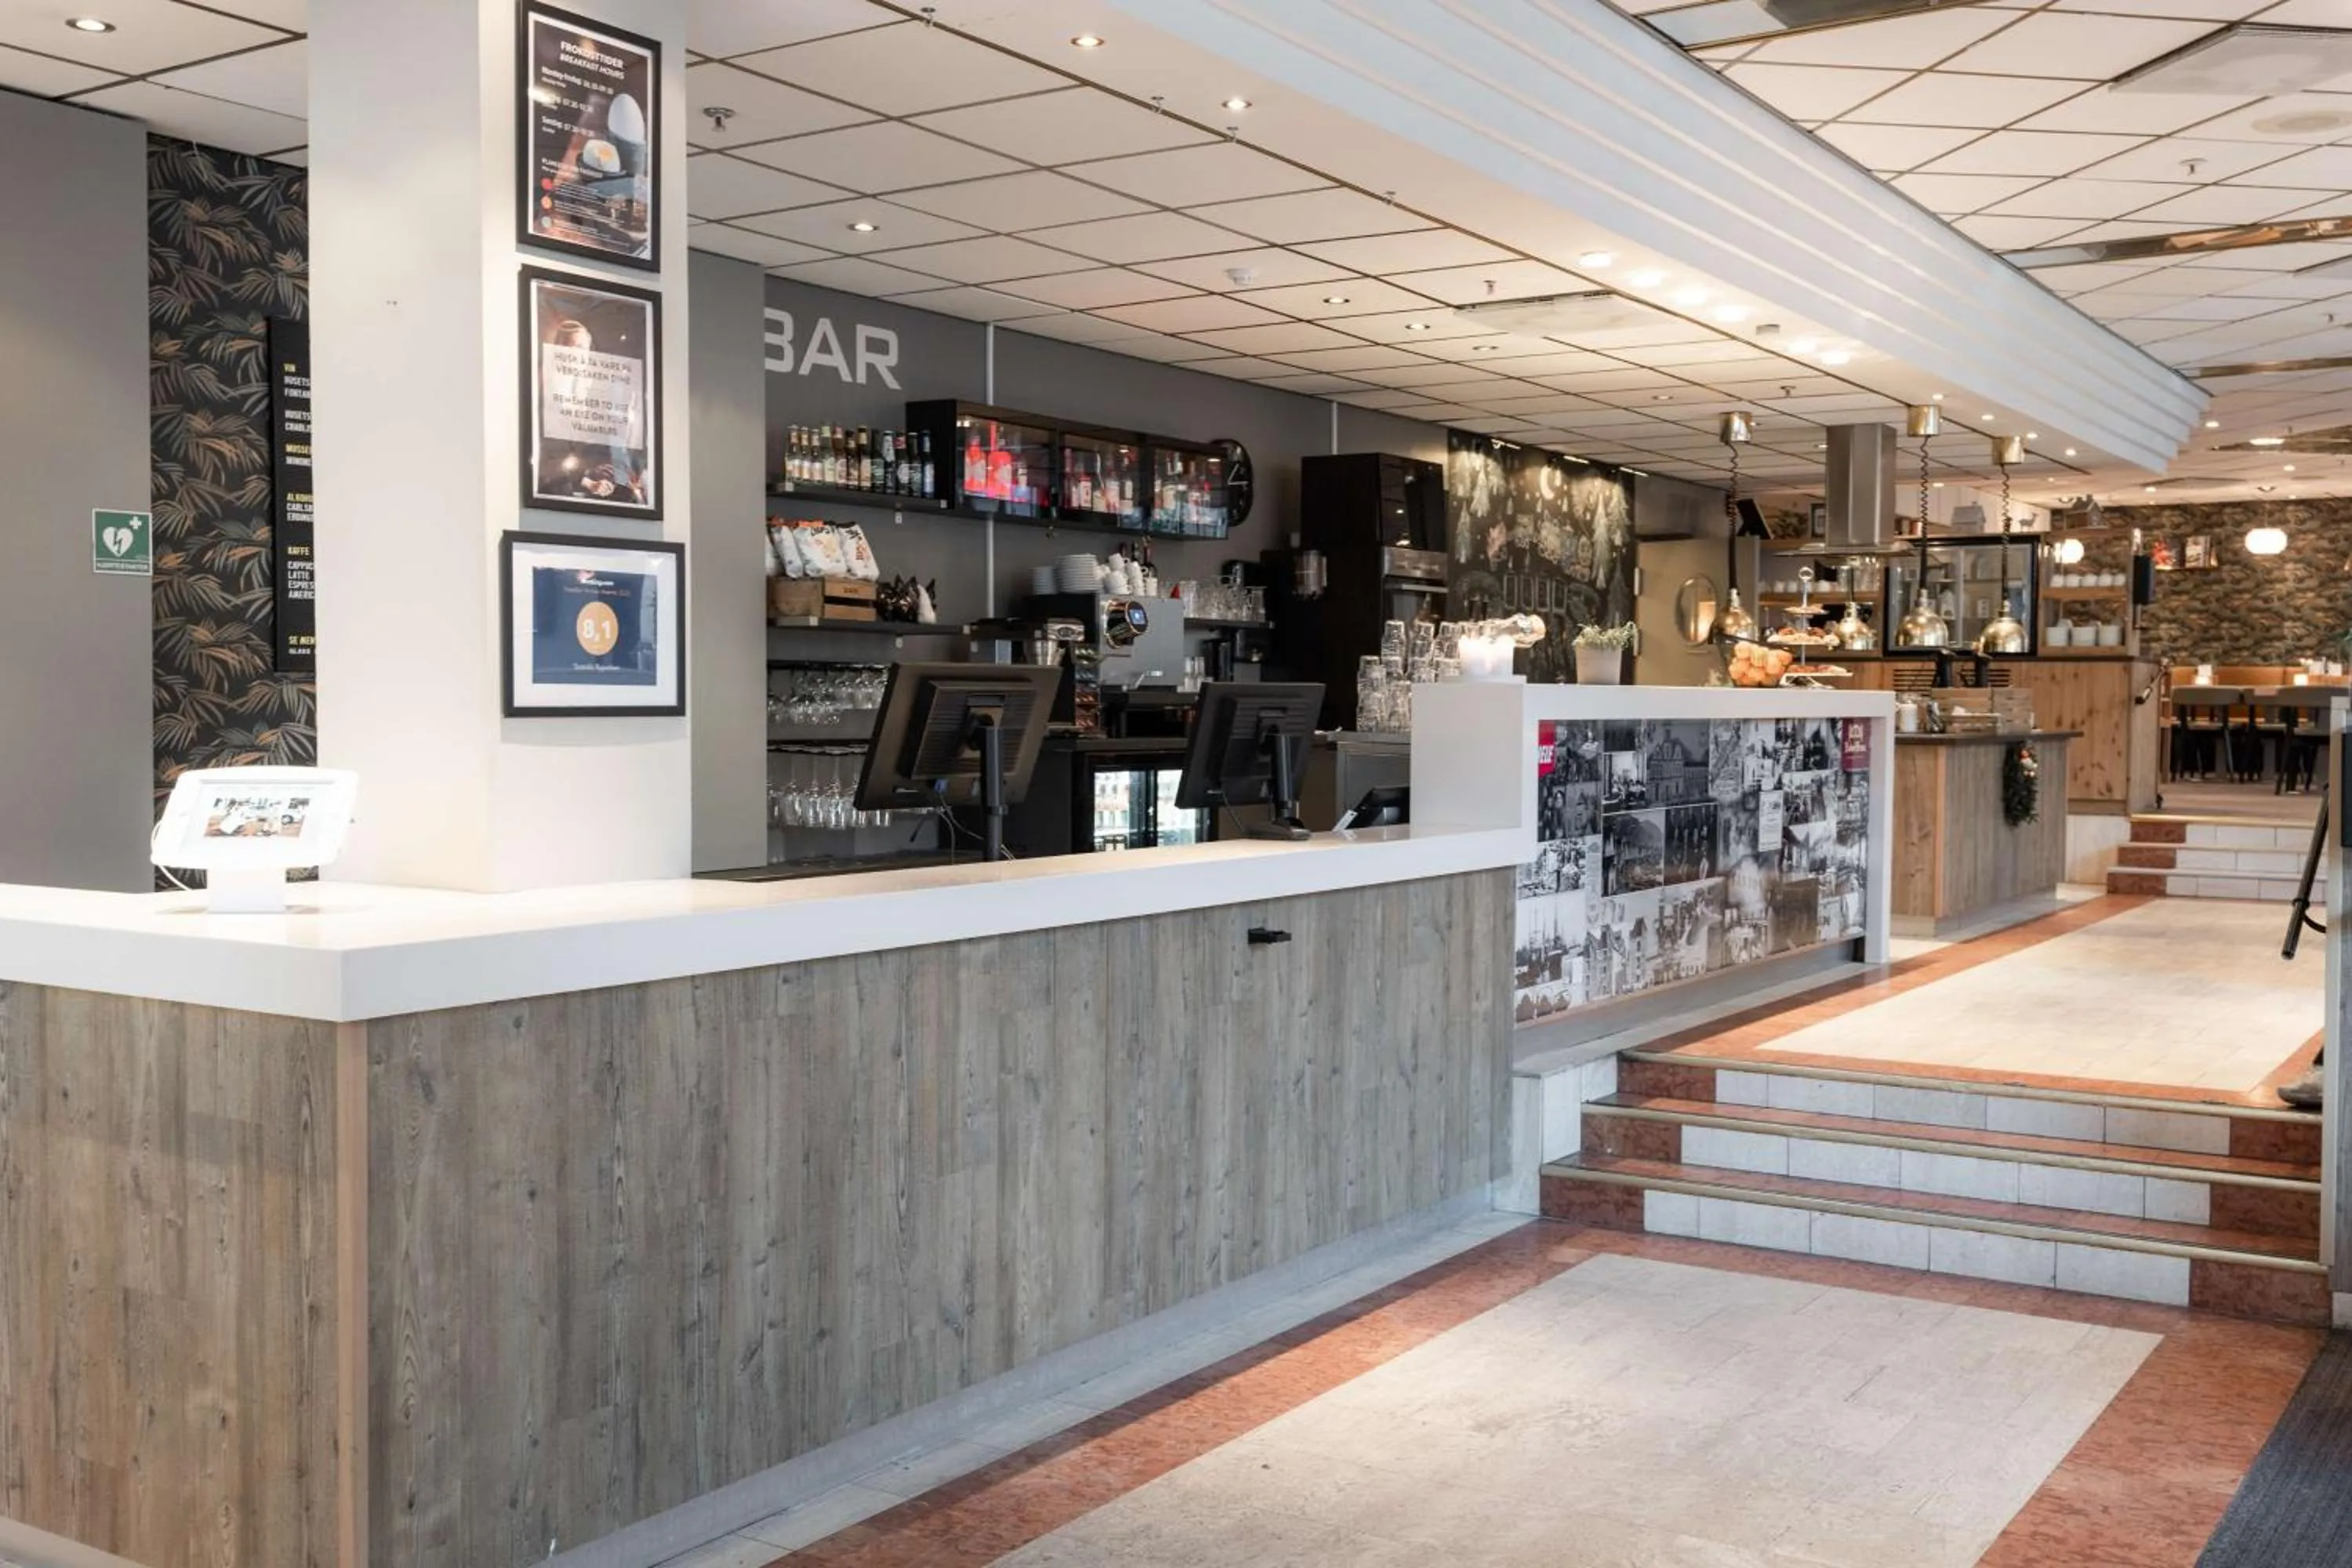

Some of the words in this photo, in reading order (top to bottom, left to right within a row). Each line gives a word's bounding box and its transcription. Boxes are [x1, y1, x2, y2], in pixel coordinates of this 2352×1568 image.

[764, 307, 902, 390] BAR
[288, 546, 310, 556] KAFFE
[288, 570, 310, 580] LATTE
